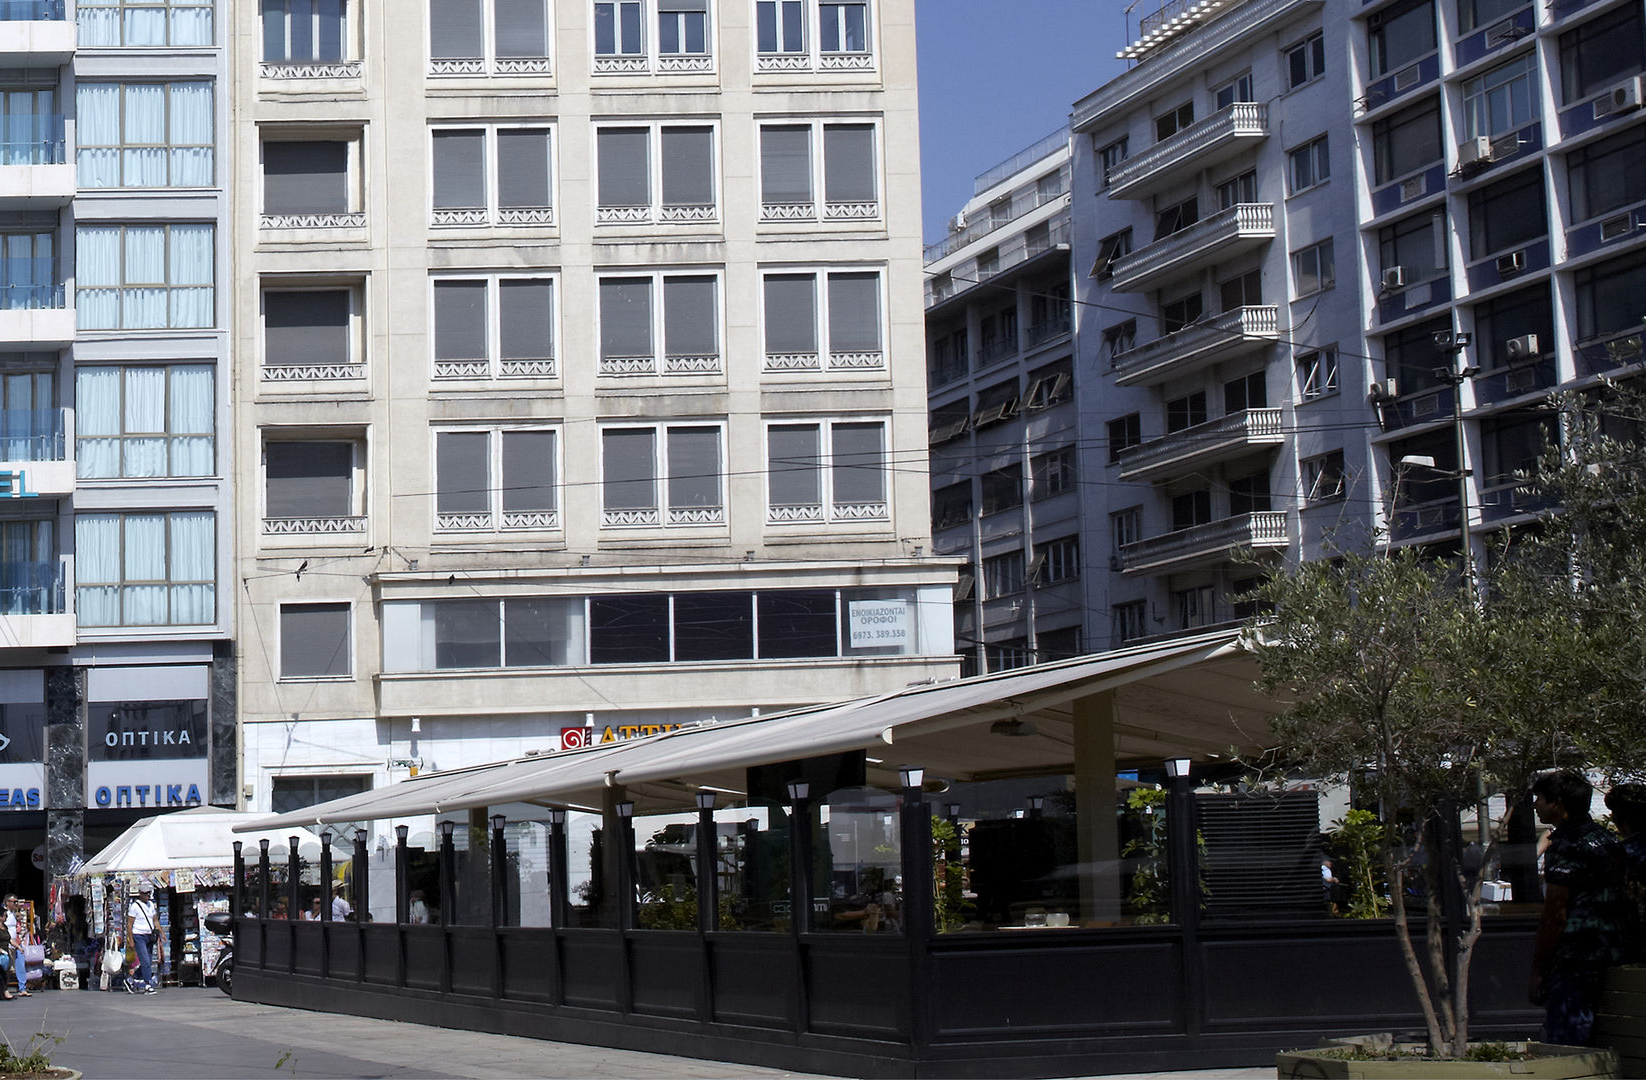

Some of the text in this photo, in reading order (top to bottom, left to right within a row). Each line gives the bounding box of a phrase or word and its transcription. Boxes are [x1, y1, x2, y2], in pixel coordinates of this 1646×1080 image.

[860, 615, 897, 625] ΟΡΟΦΟΙ
[105, 729, 191, 747] ΟΠΤΙΚΑ
[95, 783, 202, 807] ΟΠΤΙΚΑ
